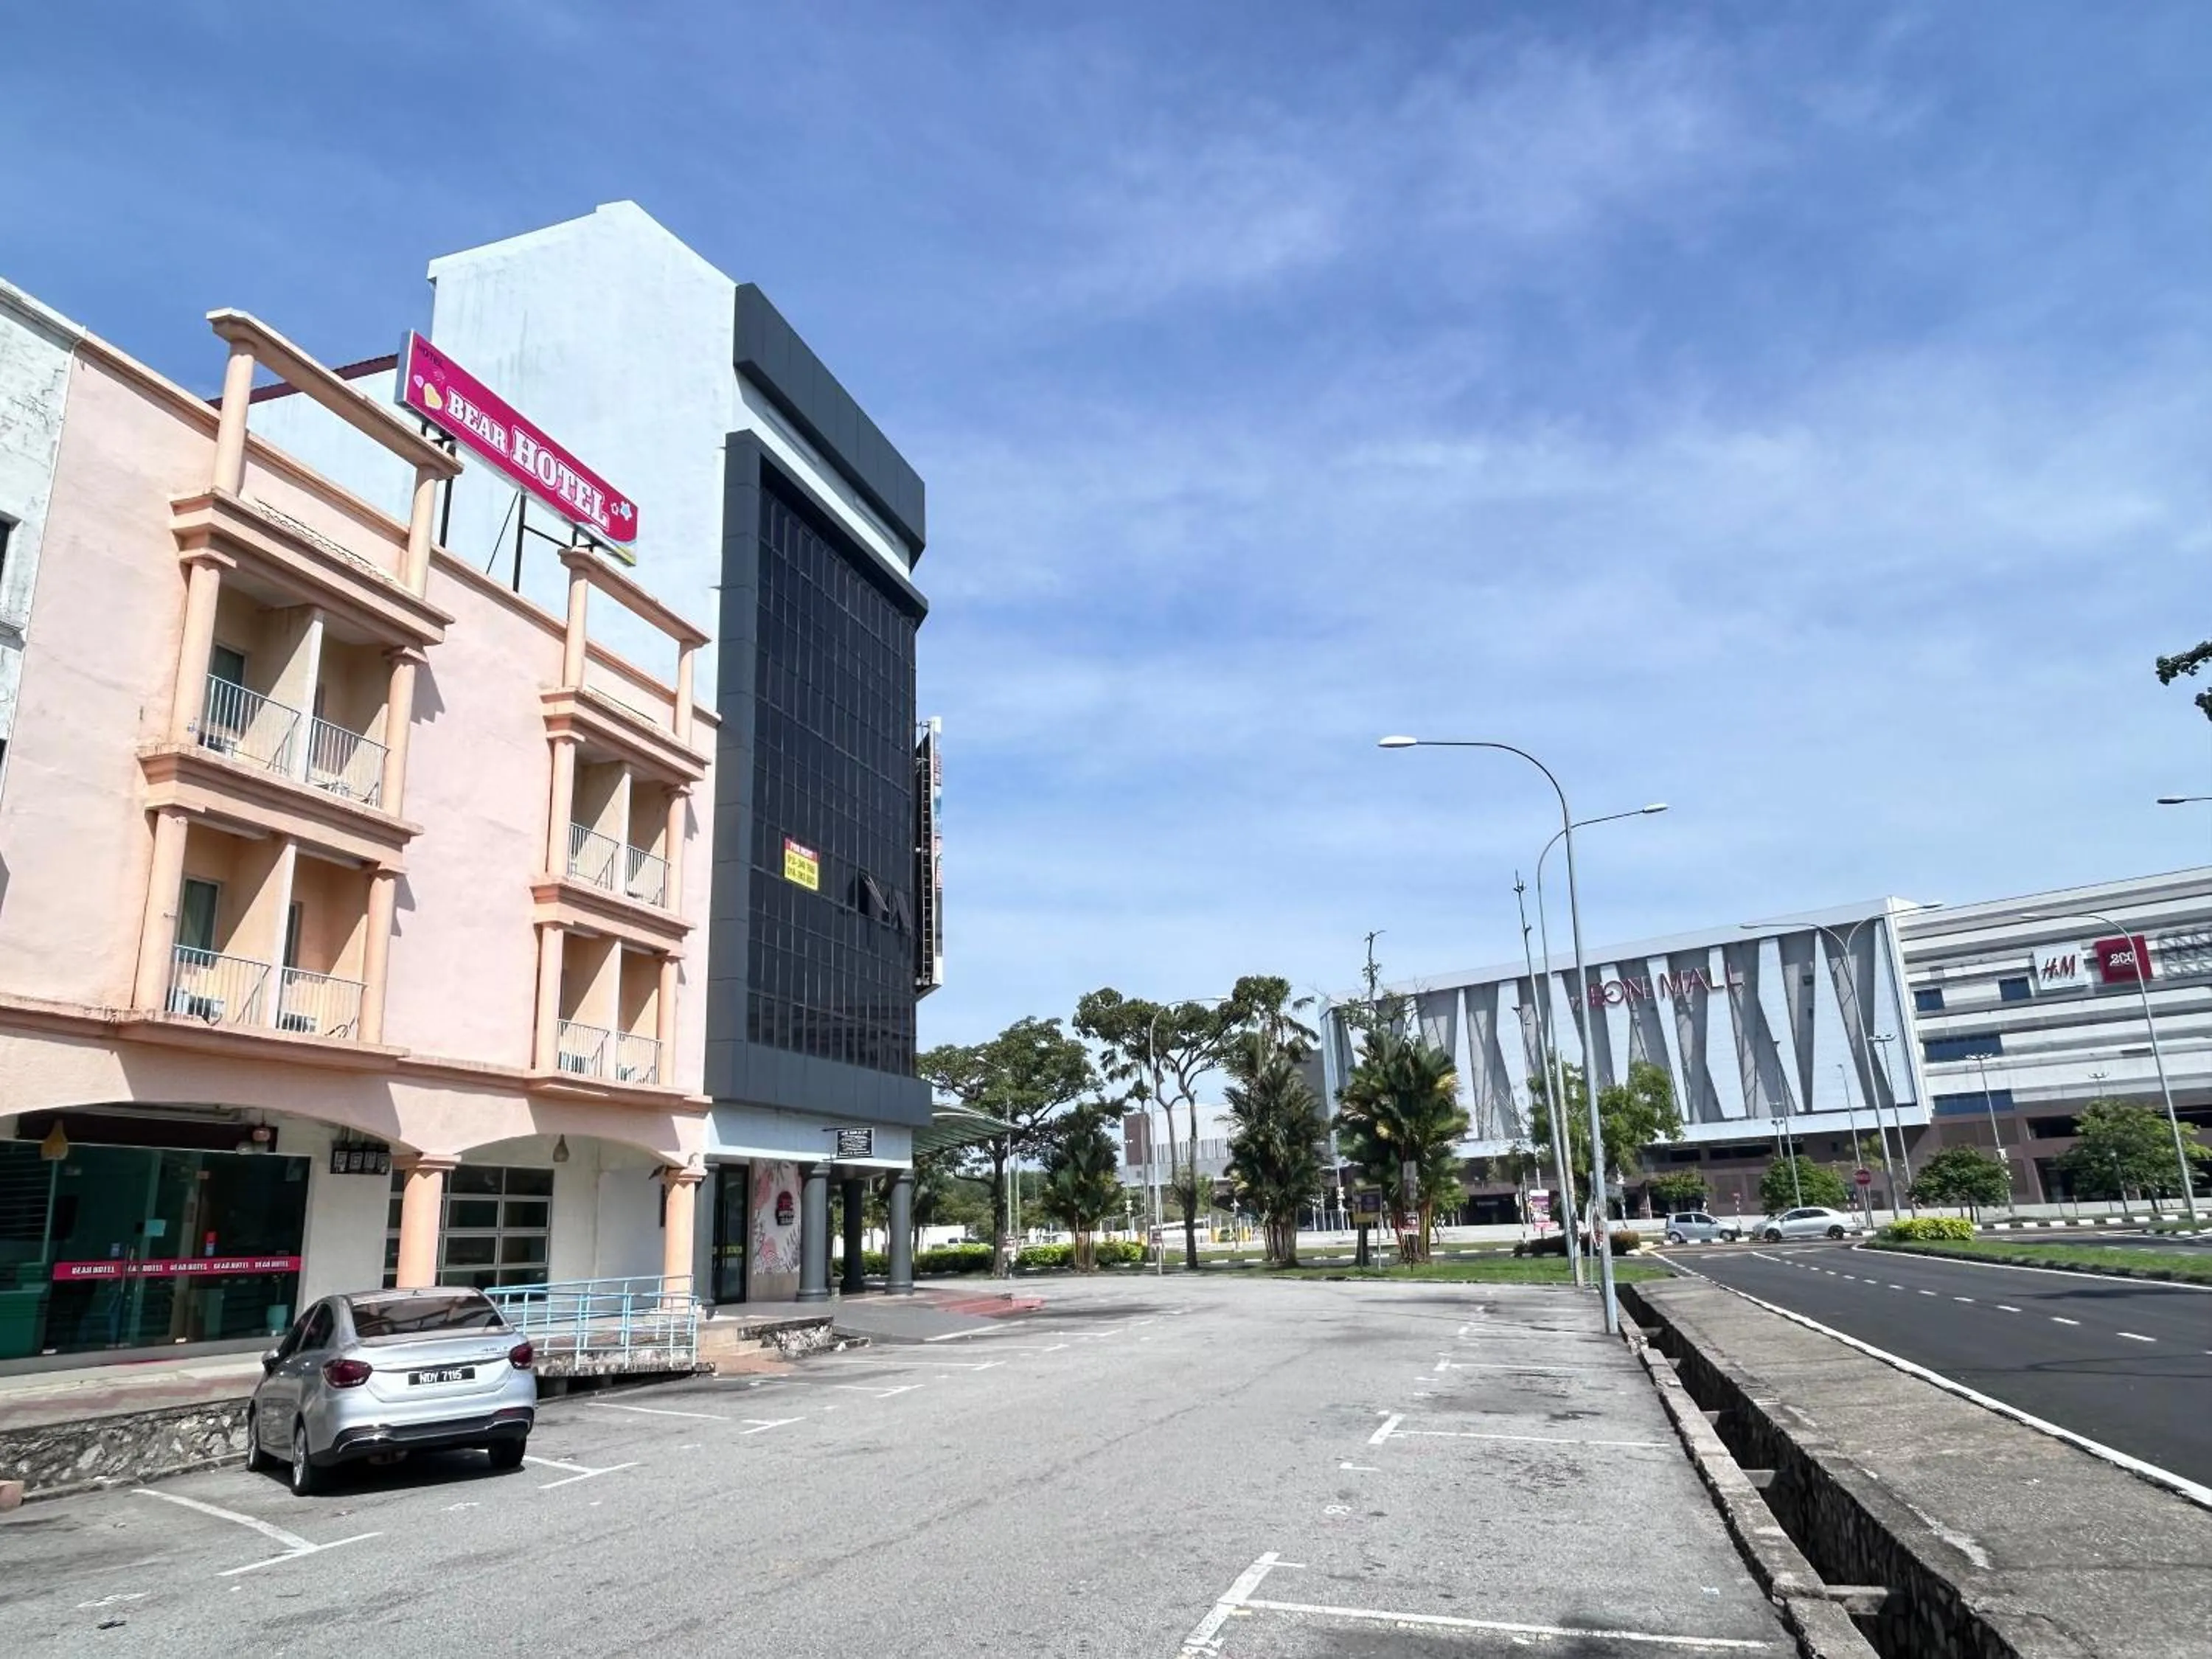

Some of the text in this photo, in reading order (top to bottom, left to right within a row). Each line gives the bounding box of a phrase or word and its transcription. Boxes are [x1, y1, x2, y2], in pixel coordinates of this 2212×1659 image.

[447, 387, 608, 531] BEAR HOTEL
[1659, 962, 1745, 998] MALL
